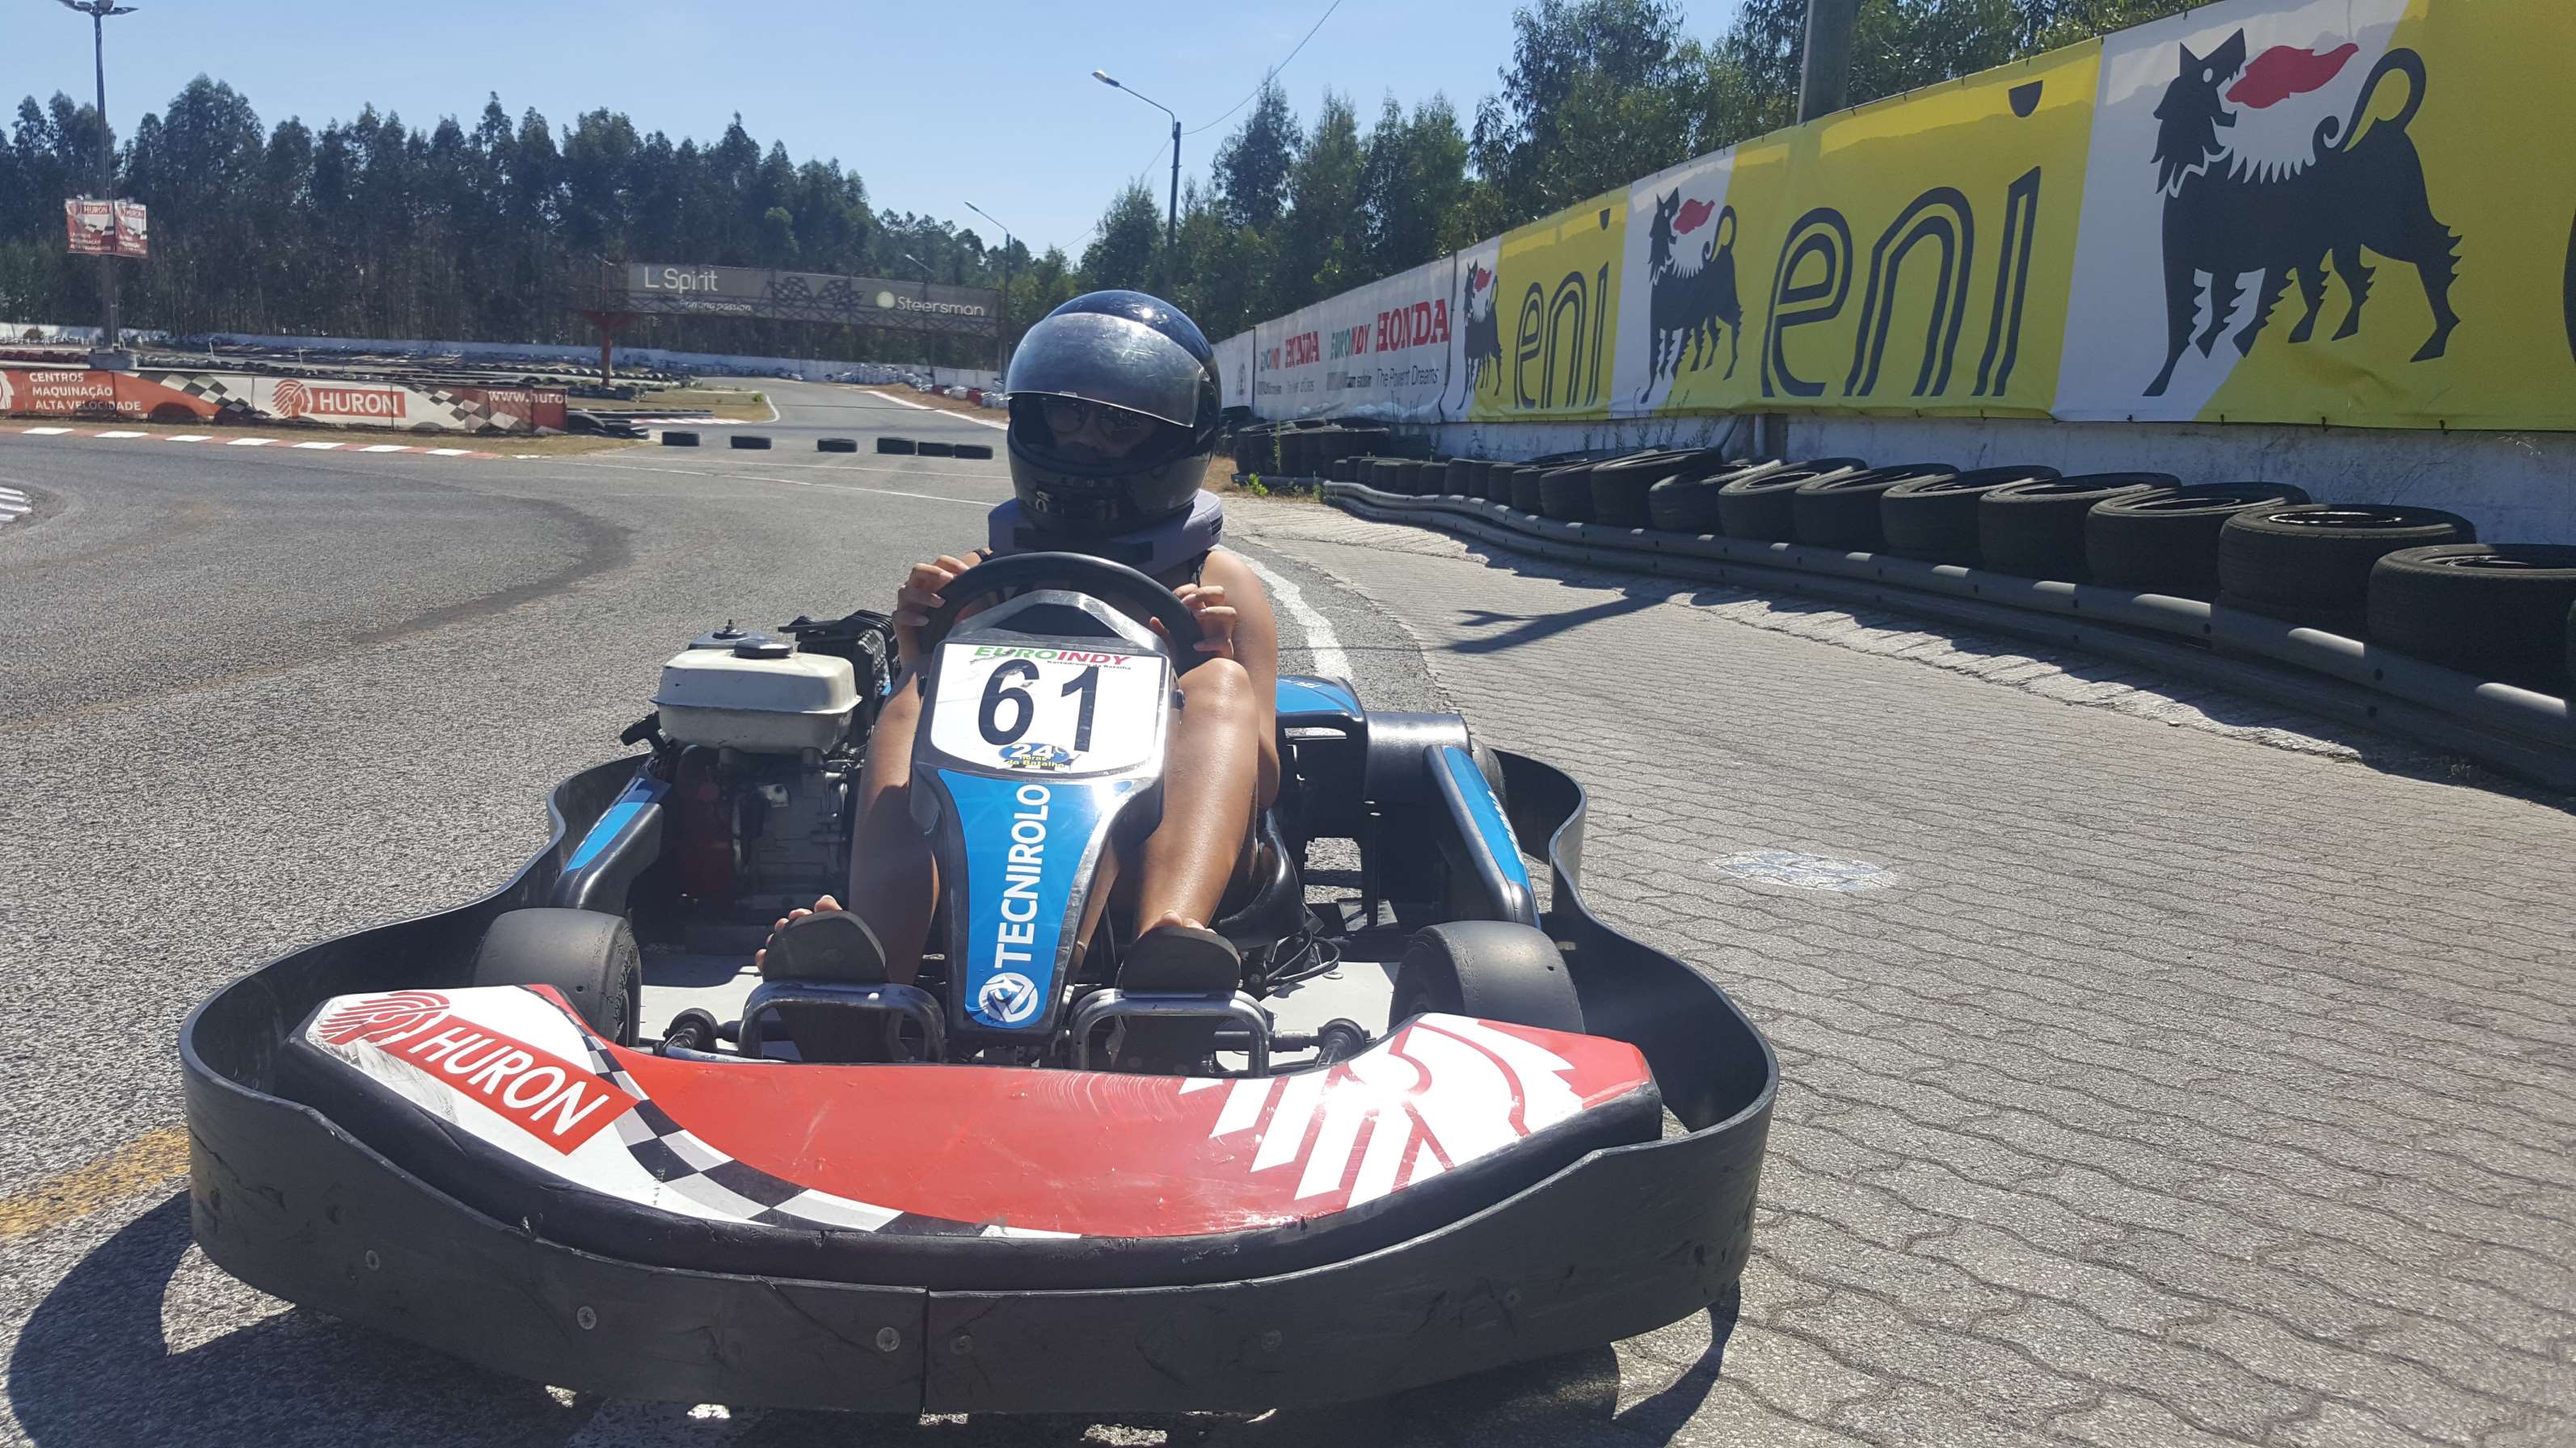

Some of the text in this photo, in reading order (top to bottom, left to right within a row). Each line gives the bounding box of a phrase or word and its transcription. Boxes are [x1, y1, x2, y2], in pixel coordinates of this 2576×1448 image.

[1760, 79, 2043, 397] eni
[664, 267, 719, 294] Spirit
[897, 296, 984, 317] Steersman
[1513, 207, 1611, 410] eni
[1376, 298, 1450, 353] HONDA
[29, 373, 85, 382] CENTROS
[32, 385, 113, 398] MAQUINAÇÃO
[319, 391, 398, 415] HURON
[36, 400, 141, 411] ALTA VELOCIDADE
[974, 646, 1132, 665] EUROINDY
[977, 658, 1100, 753] 61
[994, 784, 1052, 970] TECNIROLO
[407, 1026, 612, 1137] HURON
